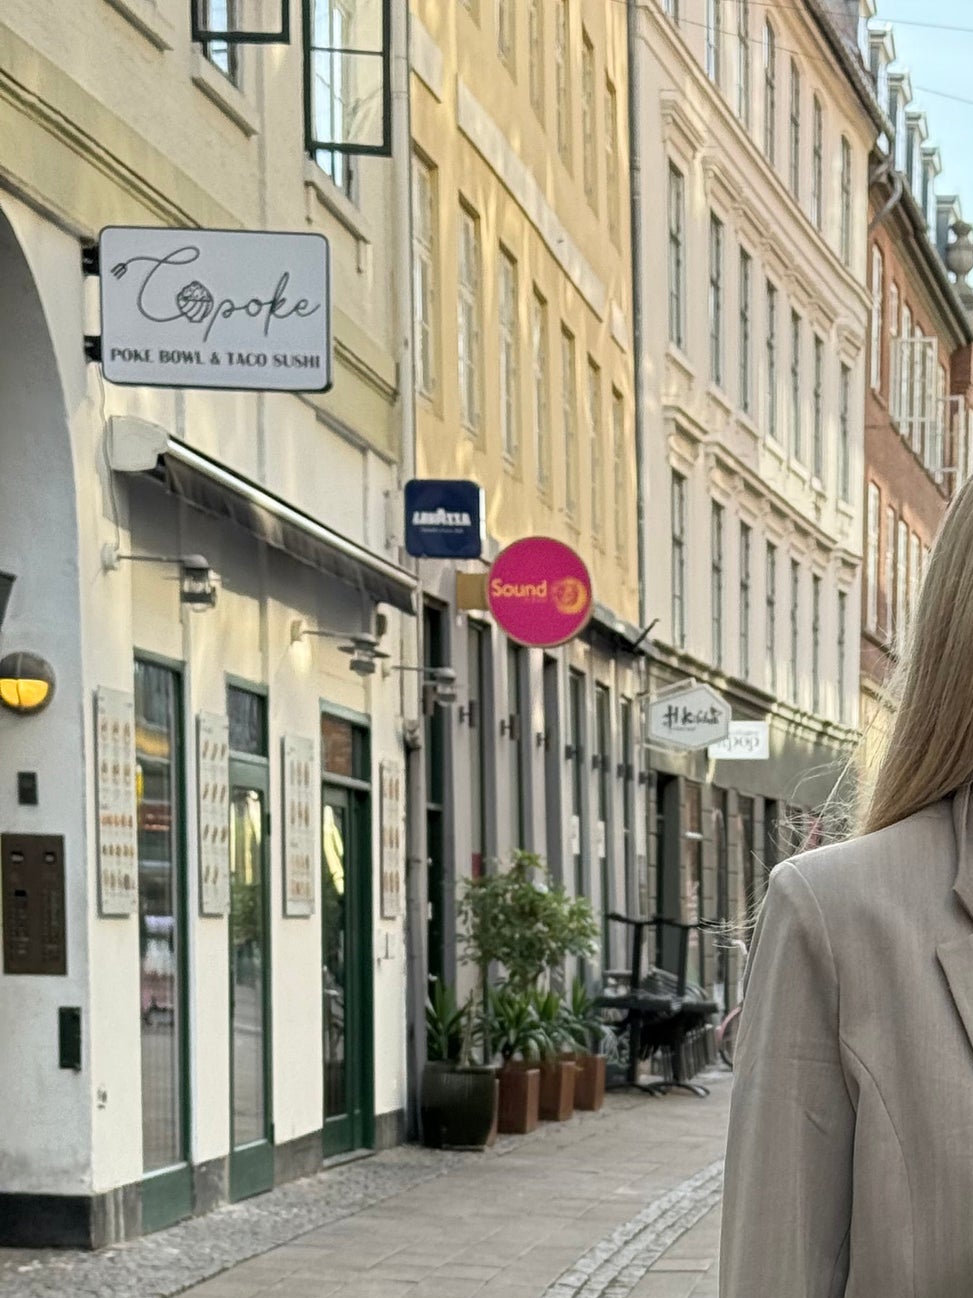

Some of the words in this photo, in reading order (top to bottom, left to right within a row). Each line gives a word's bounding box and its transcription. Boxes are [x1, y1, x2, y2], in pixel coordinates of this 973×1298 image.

[110, 348, 153, 363] POKE
[159, 350, 205, 366] BOWL
[209, 352, 221, 366] &
[227, 352, 267, 368] TACO
[272, 354, 320, 369] SUSHI
[491, 578, 547, 598] Sound
